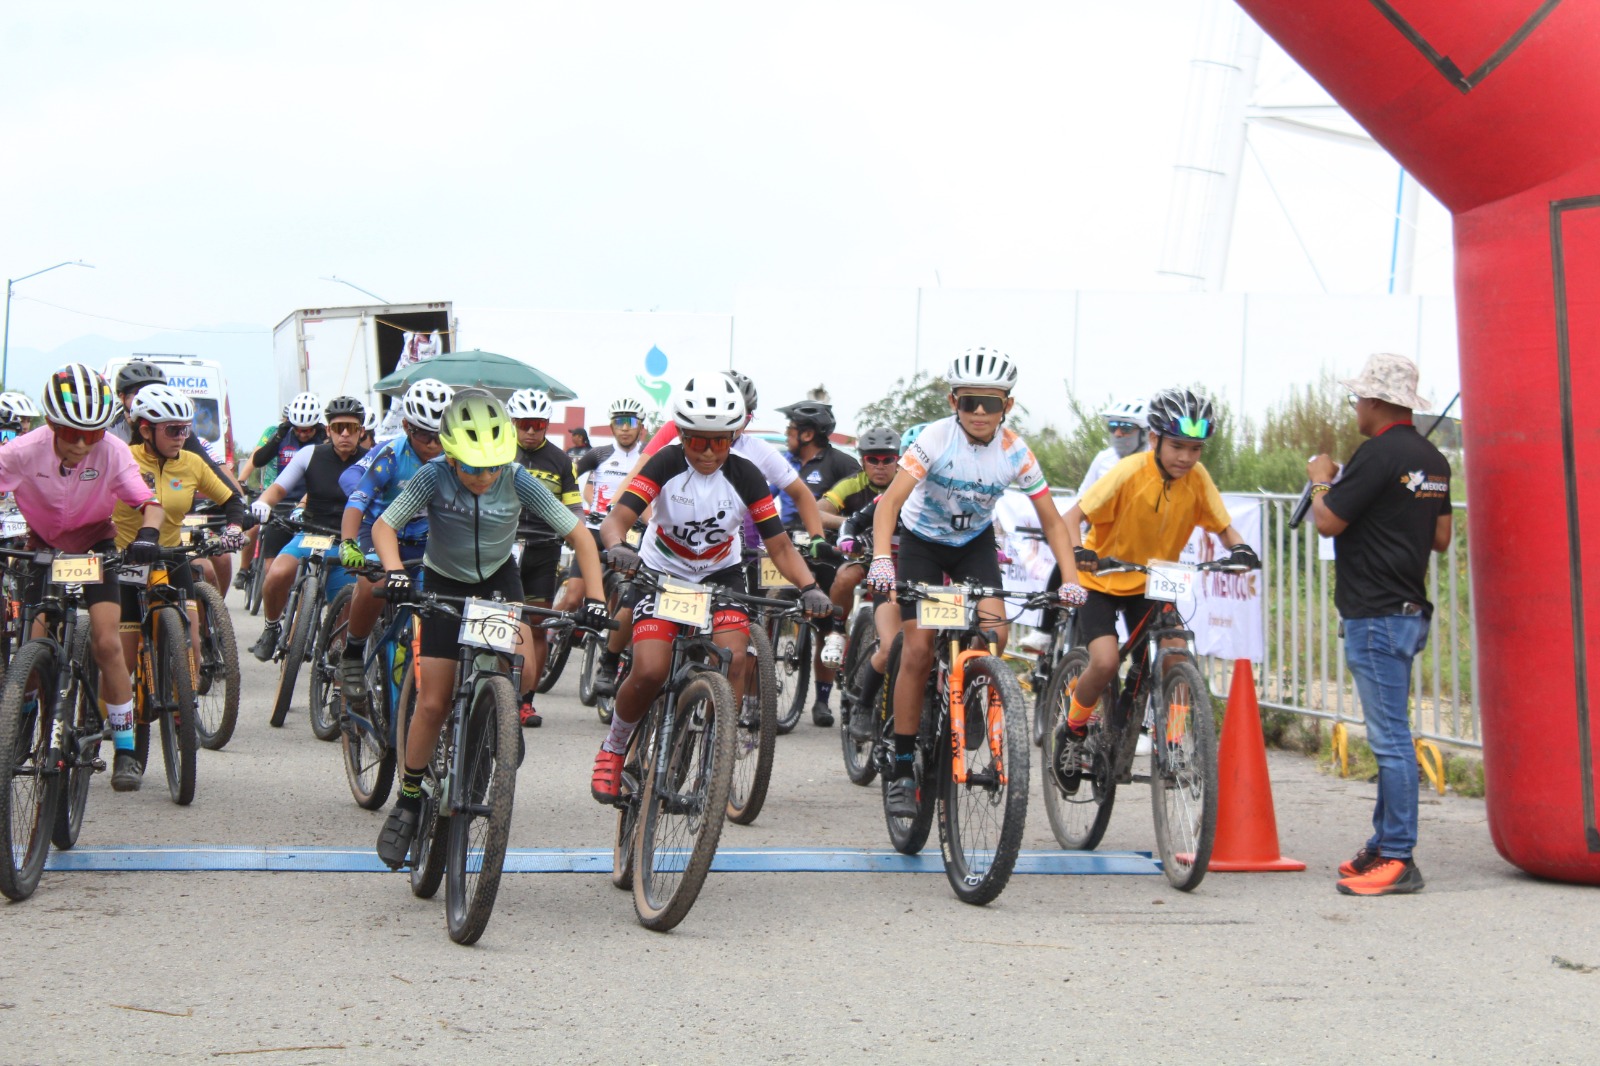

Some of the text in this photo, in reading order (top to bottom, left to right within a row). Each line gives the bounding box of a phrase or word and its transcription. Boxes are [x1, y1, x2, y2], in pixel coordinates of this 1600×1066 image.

[55, 567, 93, 578] 1704
[387, 579, 410, 588] FOX
[1153, 580, 1186, 593] 1825
[587, 606, 608, 617] FOX
[662, 598, 698, 615] 1731
[924, 607, 959, 619] 1723
[468, 621, 507, 640] 1770
[637, 624, 659, 634] CENTRO
